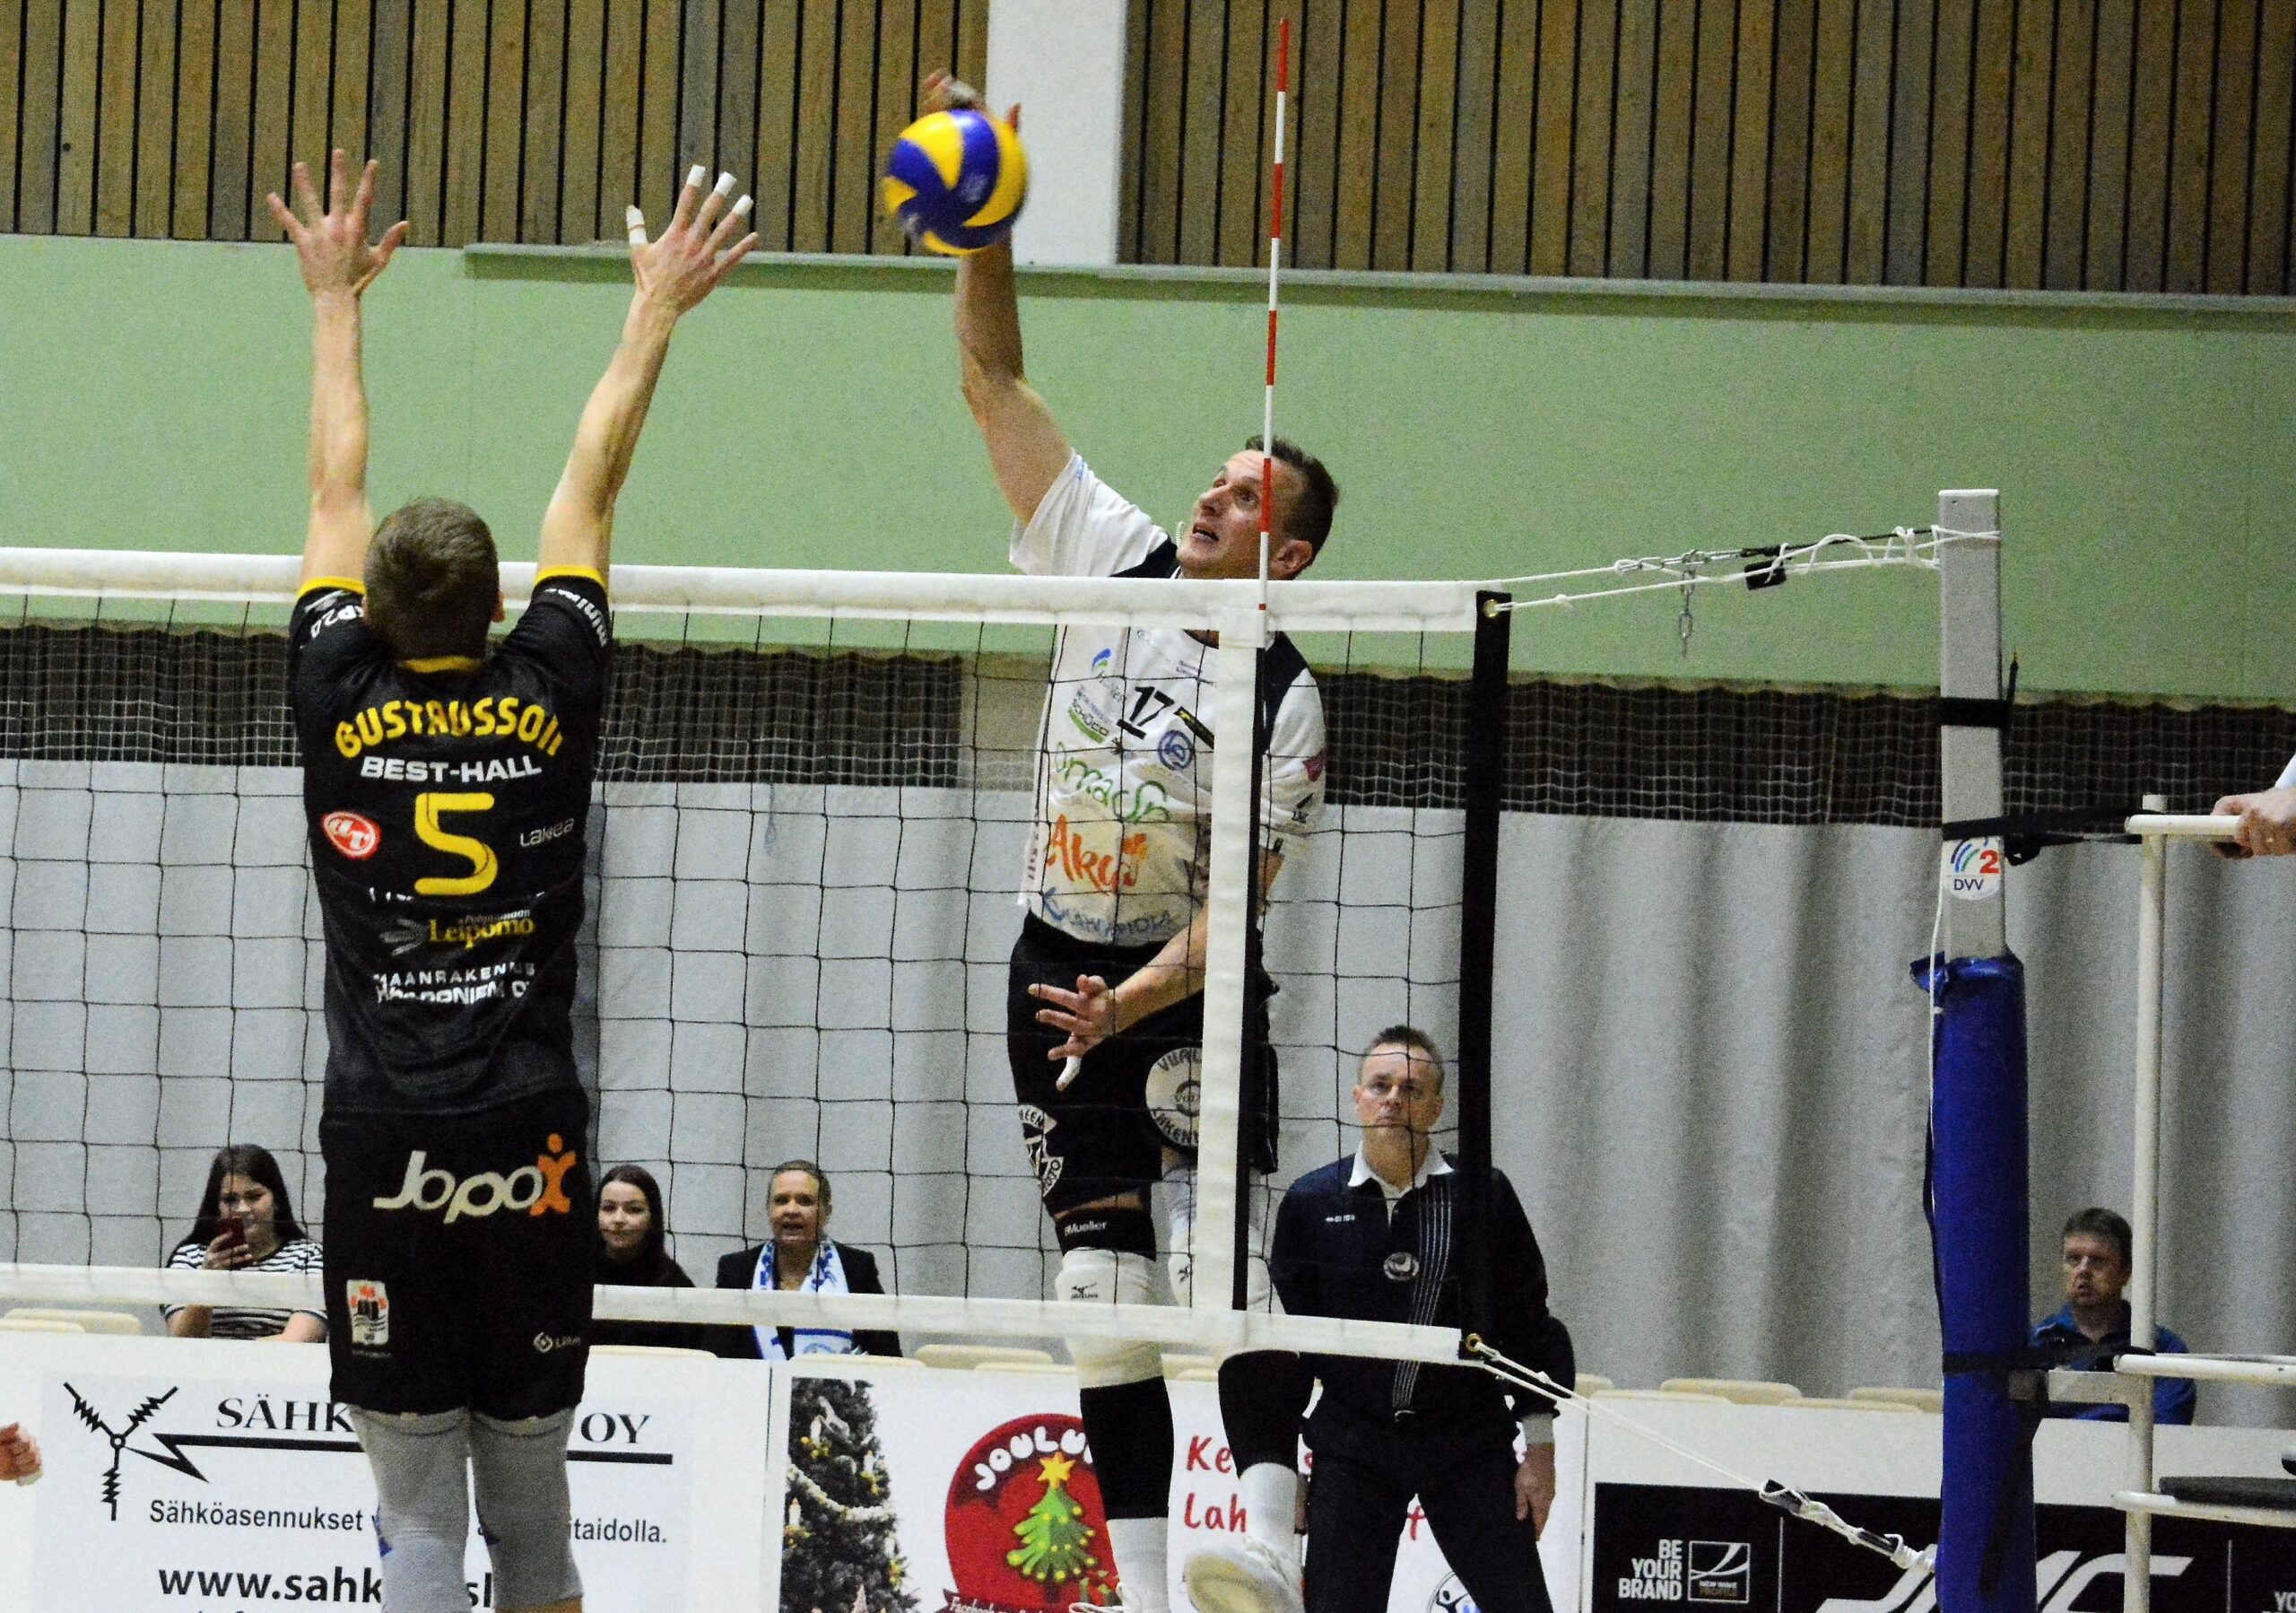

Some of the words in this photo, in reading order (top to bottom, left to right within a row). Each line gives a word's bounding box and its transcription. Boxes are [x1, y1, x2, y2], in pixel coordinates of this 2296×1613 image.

[361, 755, 542, 782] BEST-HALL
[414, 793, 498, 895] 5
[1979, 850, 1999, 874] 2
[1953, 878, 1984, 891] DVV
[216, 1393, 356, 1433] SÄHK
[580, 1412, 651, 1444] OY
[150, 1499, 364, 1531] Sähköasennukset
[573, 1517, 667, 1544] taidolla.
[1659, 1539, 1683, 1560] BE
[1631, 1558, 1683, 1580] YOUR
[1618, 1578, 1683, 1600] BRAND
